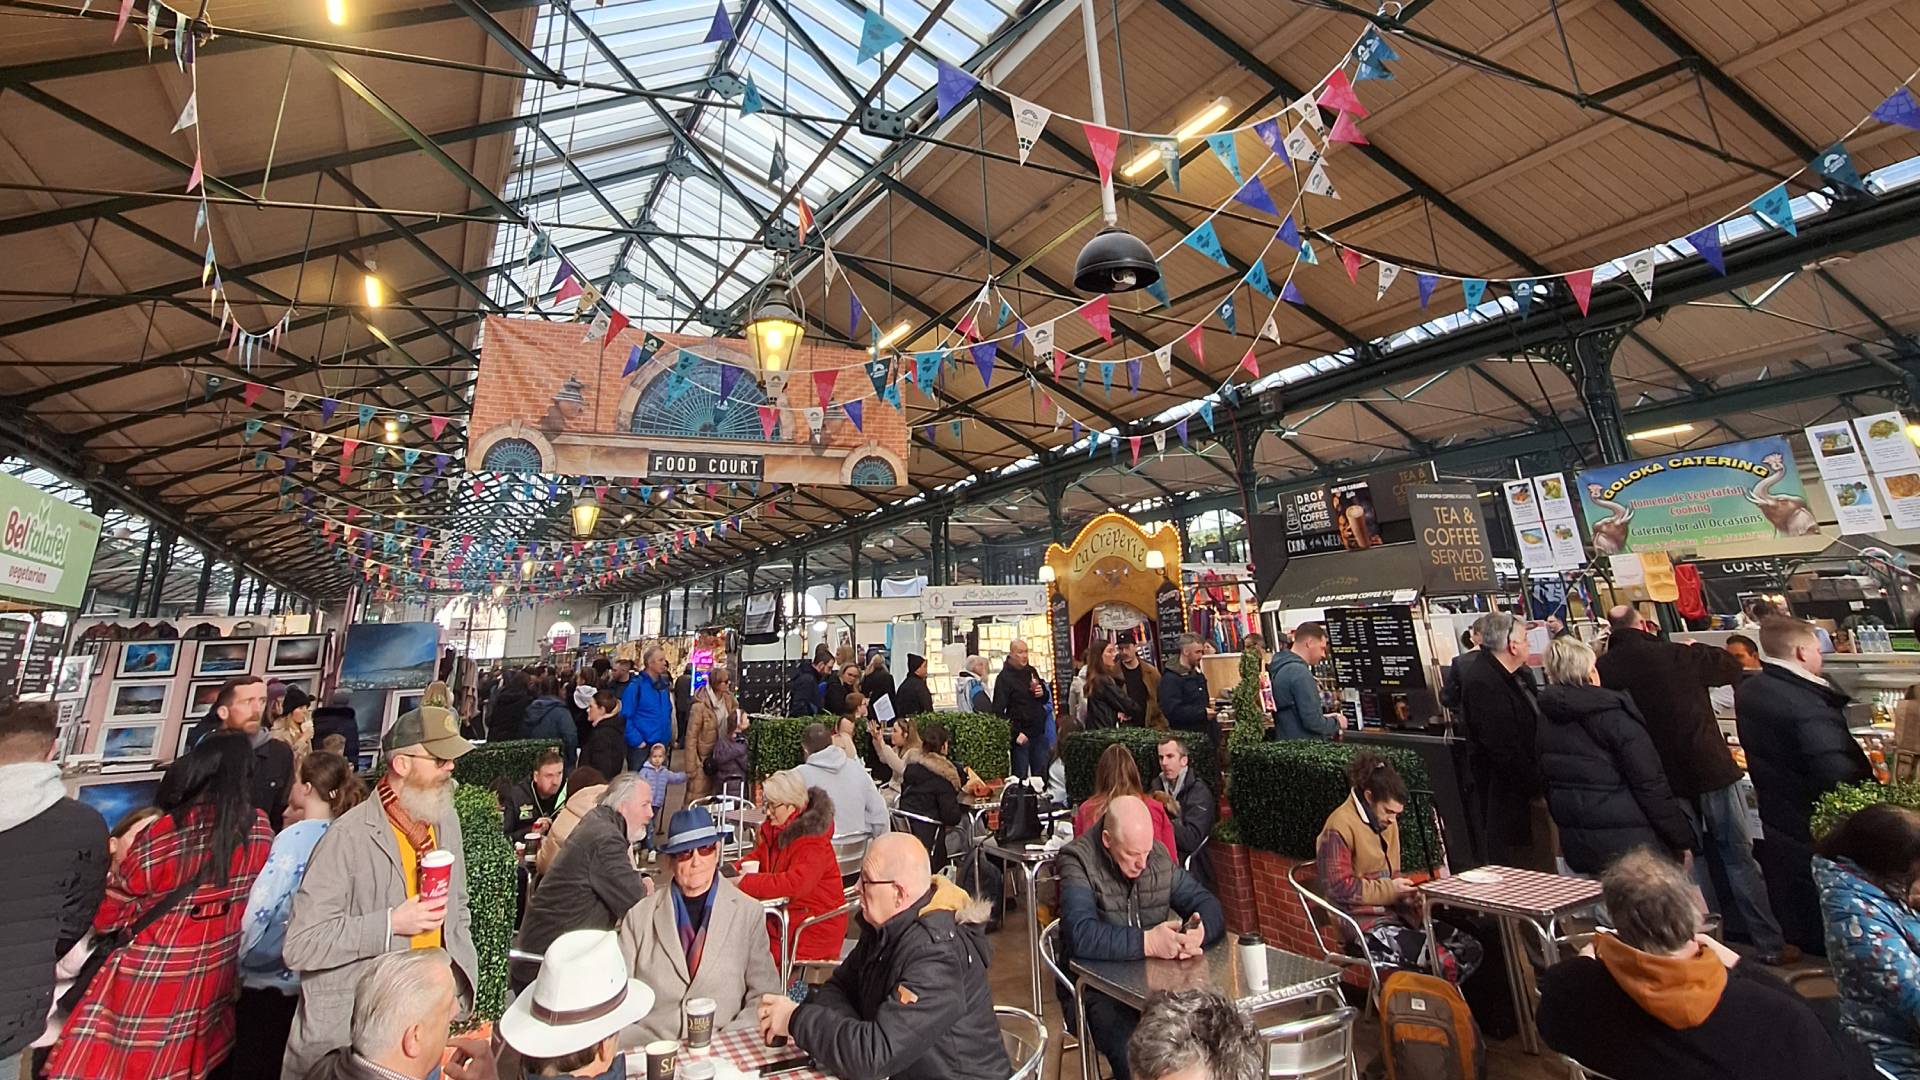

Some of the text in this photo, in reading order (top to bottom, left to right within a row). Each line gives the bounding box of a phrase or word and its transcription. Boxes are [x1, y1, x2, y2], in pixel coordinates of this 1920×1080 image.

[654, 456, 758, 474] FOOD COURT
[1603, 455, 1770, 501] GOLOKA CATERING
[1296, 490, 1324, 504] DROP
[1630, 493, 1684, 509] Homemade
[1299, 501, 1327, 513] HOPPER
[1669, 503, 1711, 517] Cooking
[1300, 510, 1330, 523] COFFEE
[1433, 506, 1476, 525] TEA &
[1302, 520, 1331, 531] ROASTERS
[1631, 513, 1763, 537] Catering for all Occasions
[1423, 527, 1481, 546] COFFEE
[1073, 528, 1146, 573] La Crêperie
[1431, 548, 1485, 565] SERVED
[9, 565, 48, 584] vegetarian
[1452, 566, 1489, 582] HERE
[1358, 591, 1382, 599] COFFEE
